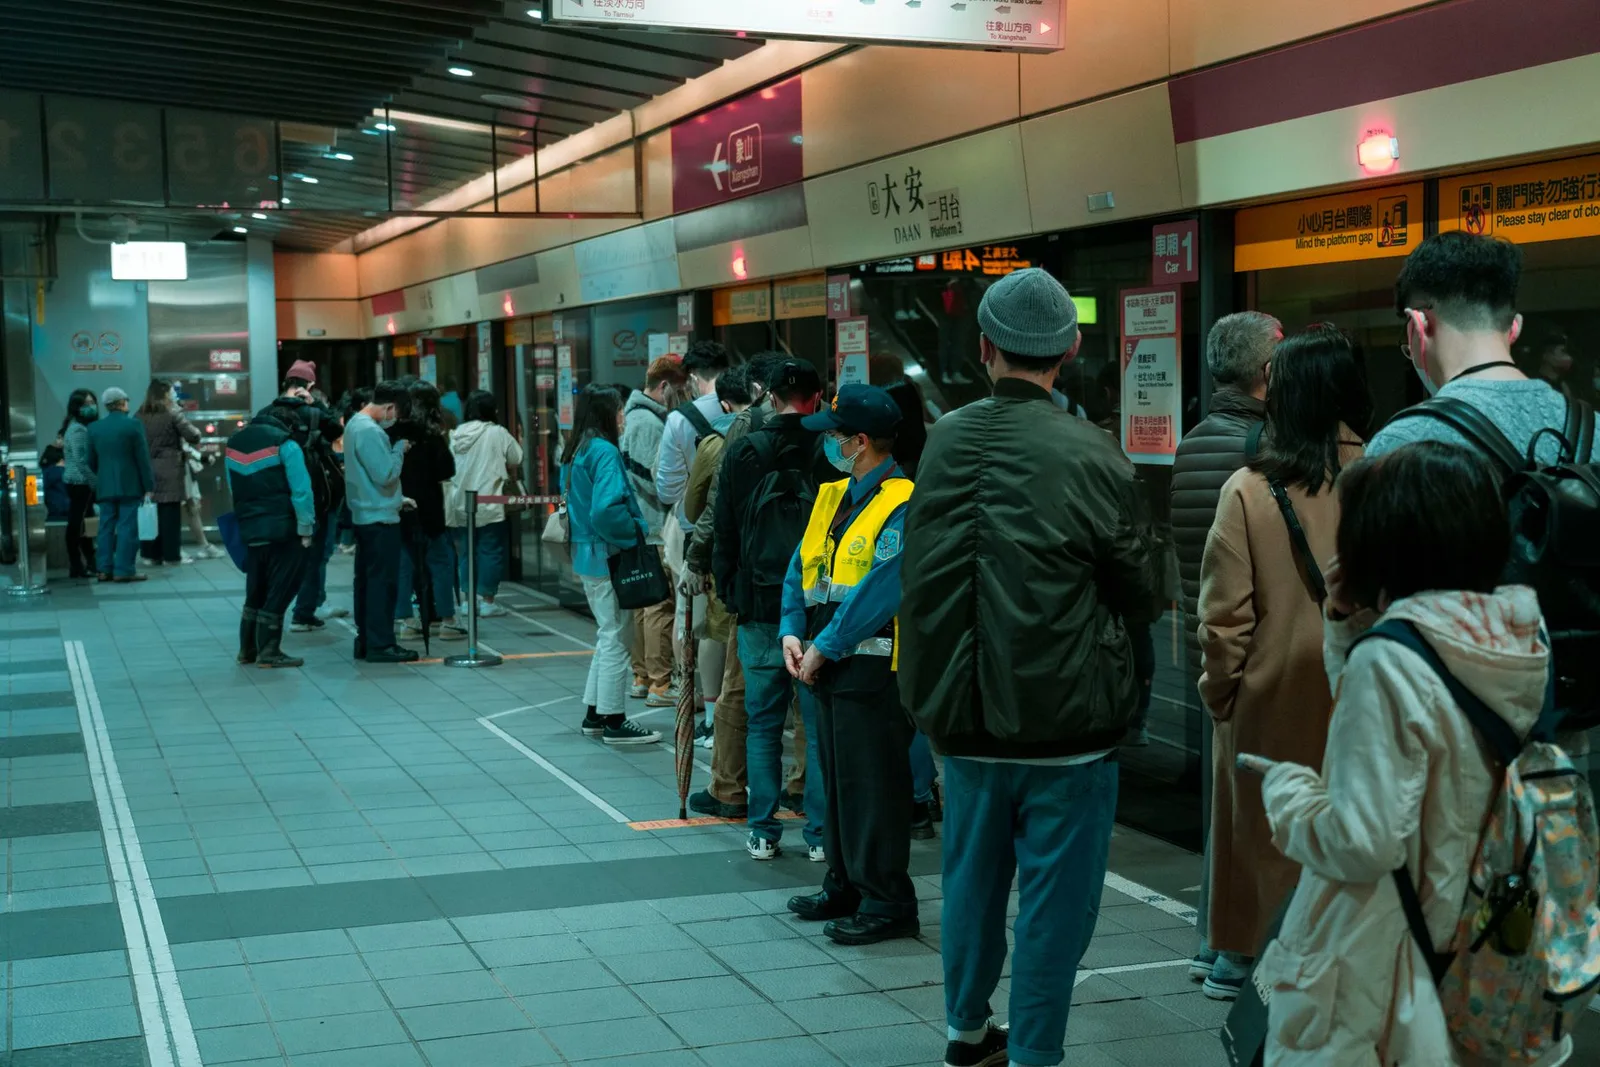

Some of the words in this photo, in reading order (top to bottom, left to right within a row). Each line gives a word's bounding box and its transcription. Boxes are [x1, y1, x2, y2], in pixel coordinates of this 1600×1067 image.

[986, 21, 1032, 33] 往象山方向
[736, 135, 753, 164] 象山
[881, 166, 924, 218] 大安
[928, 193, 960, 222] 二月台
[1297, 203, 1372, 234] 小心月台間隙
[1496, 213, 1526, 228] Please
[1528, 211, 1546, 226] stay
[1548, 207, 1571, 221] clear
[1573, 205, 1583, 219] of
[894, 223, 921, 244] DAAN
[930, 224, 957, 239] Platform
[957, 221, 962, 233] 2
[1296, 238, 1312, 249] Mind
[1314, 235, 1325, 247] the
[1327, 233, 1357, 248] platform
[1358, 232, 1373, 245] gap
[1182, 231, 1192, 271] 1
[1165, 261, 1179, 274] Car
